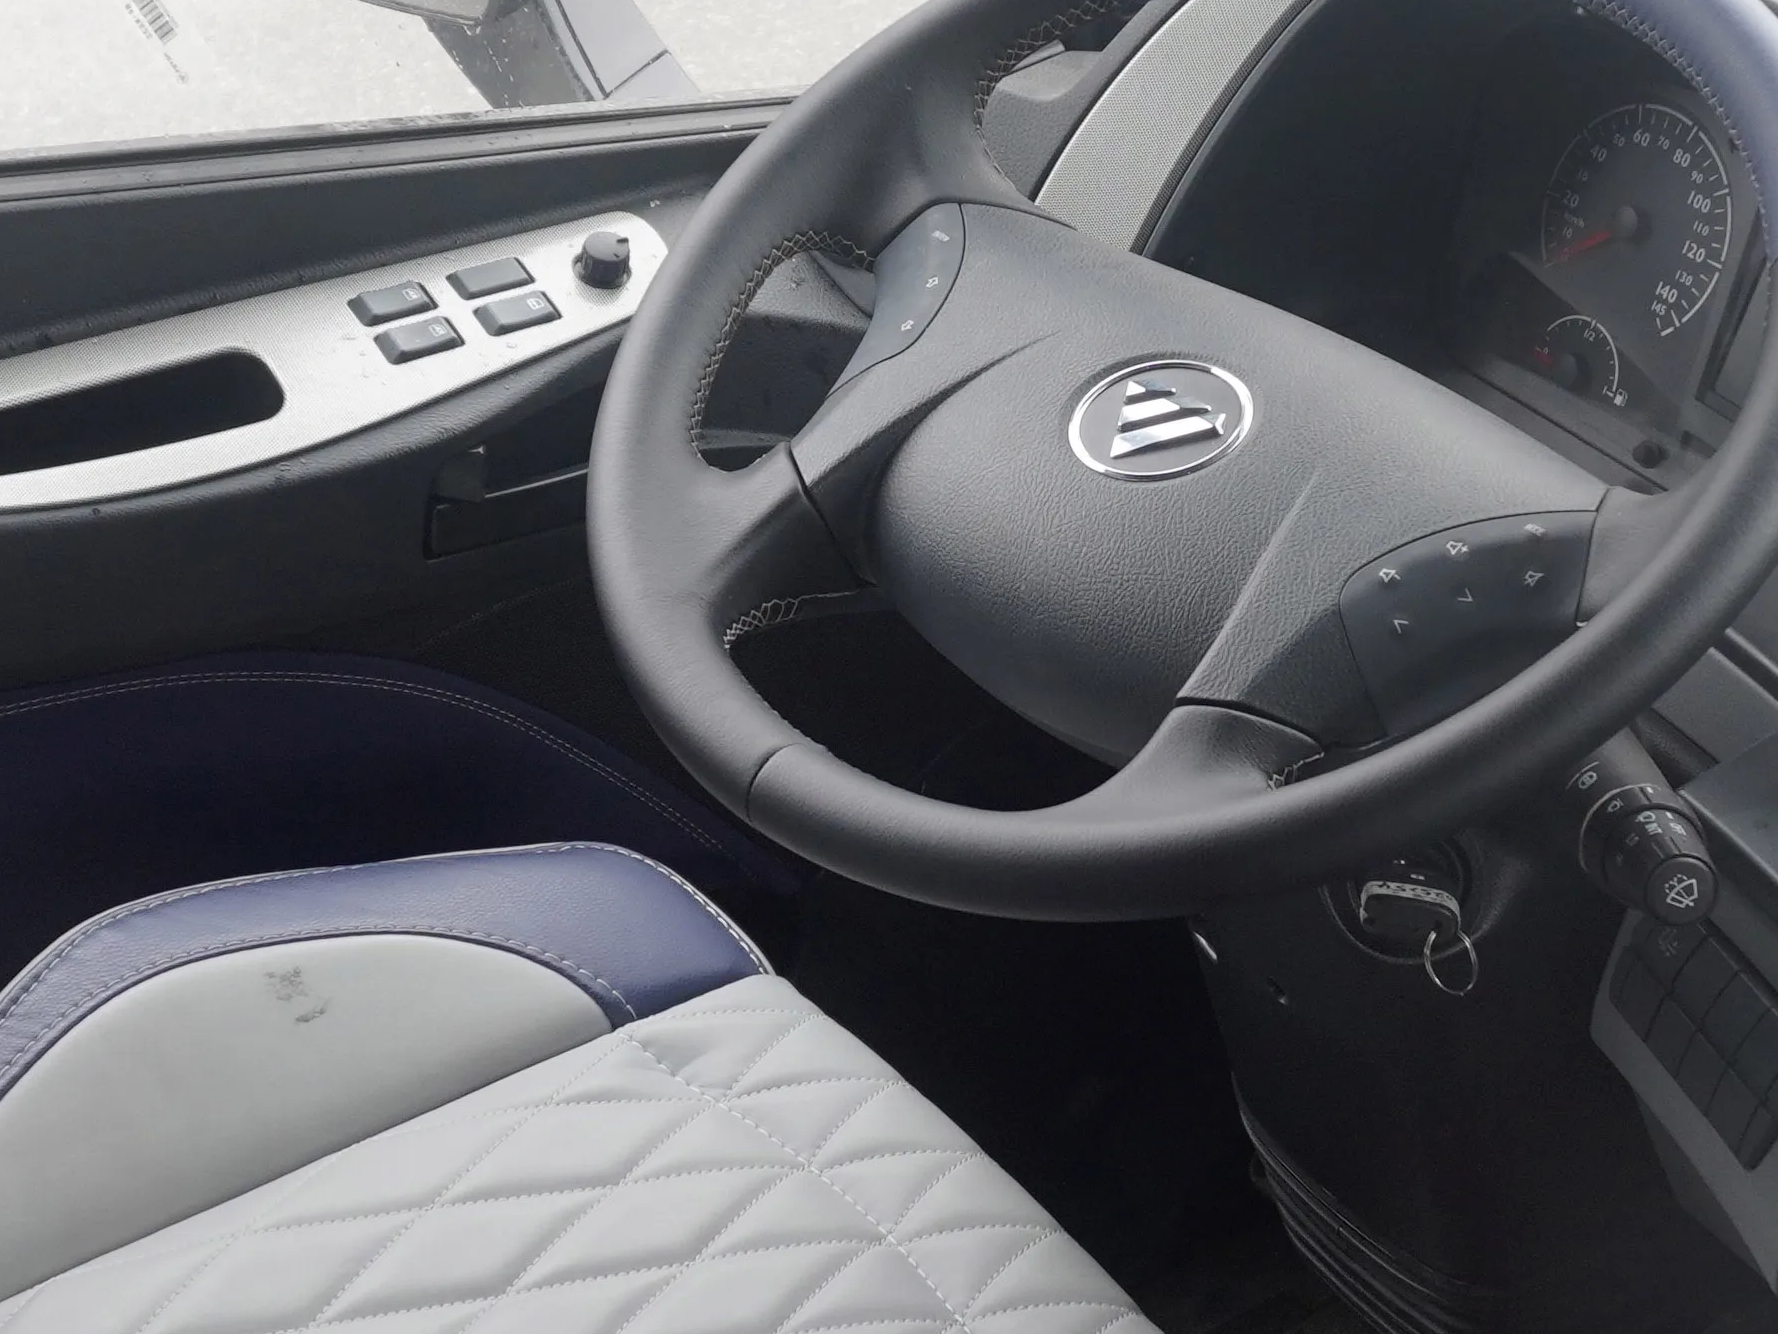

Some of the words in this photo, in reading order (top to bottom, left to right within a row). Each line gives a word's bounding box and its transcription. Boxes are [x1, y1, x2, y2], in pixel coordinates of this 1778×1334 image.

[1613, 133, 1625, 147] 50
[1633, 129, 1651, 146] 60
[1658, 136, 1670, 149] 70
[1590, 145, 1608, 162] 40
[1673, 148, 1691, 167] 80
[1690, 170, 1704, 184] 90
[1563, 189, 1580, 208] 20
[1687, 190, 1712, 213] 100
[1563, 226, 1573, 239] 10
[1693, 220, 1710, 237] 110
[1682, 240, 1706, 263] 120
[1675, 269, 1693, 286] 130
[1655, 281, 1678, 303] 140
[1651, 300, 1667, 316] 145
[1583, 329, 1596, 342] 1/2
